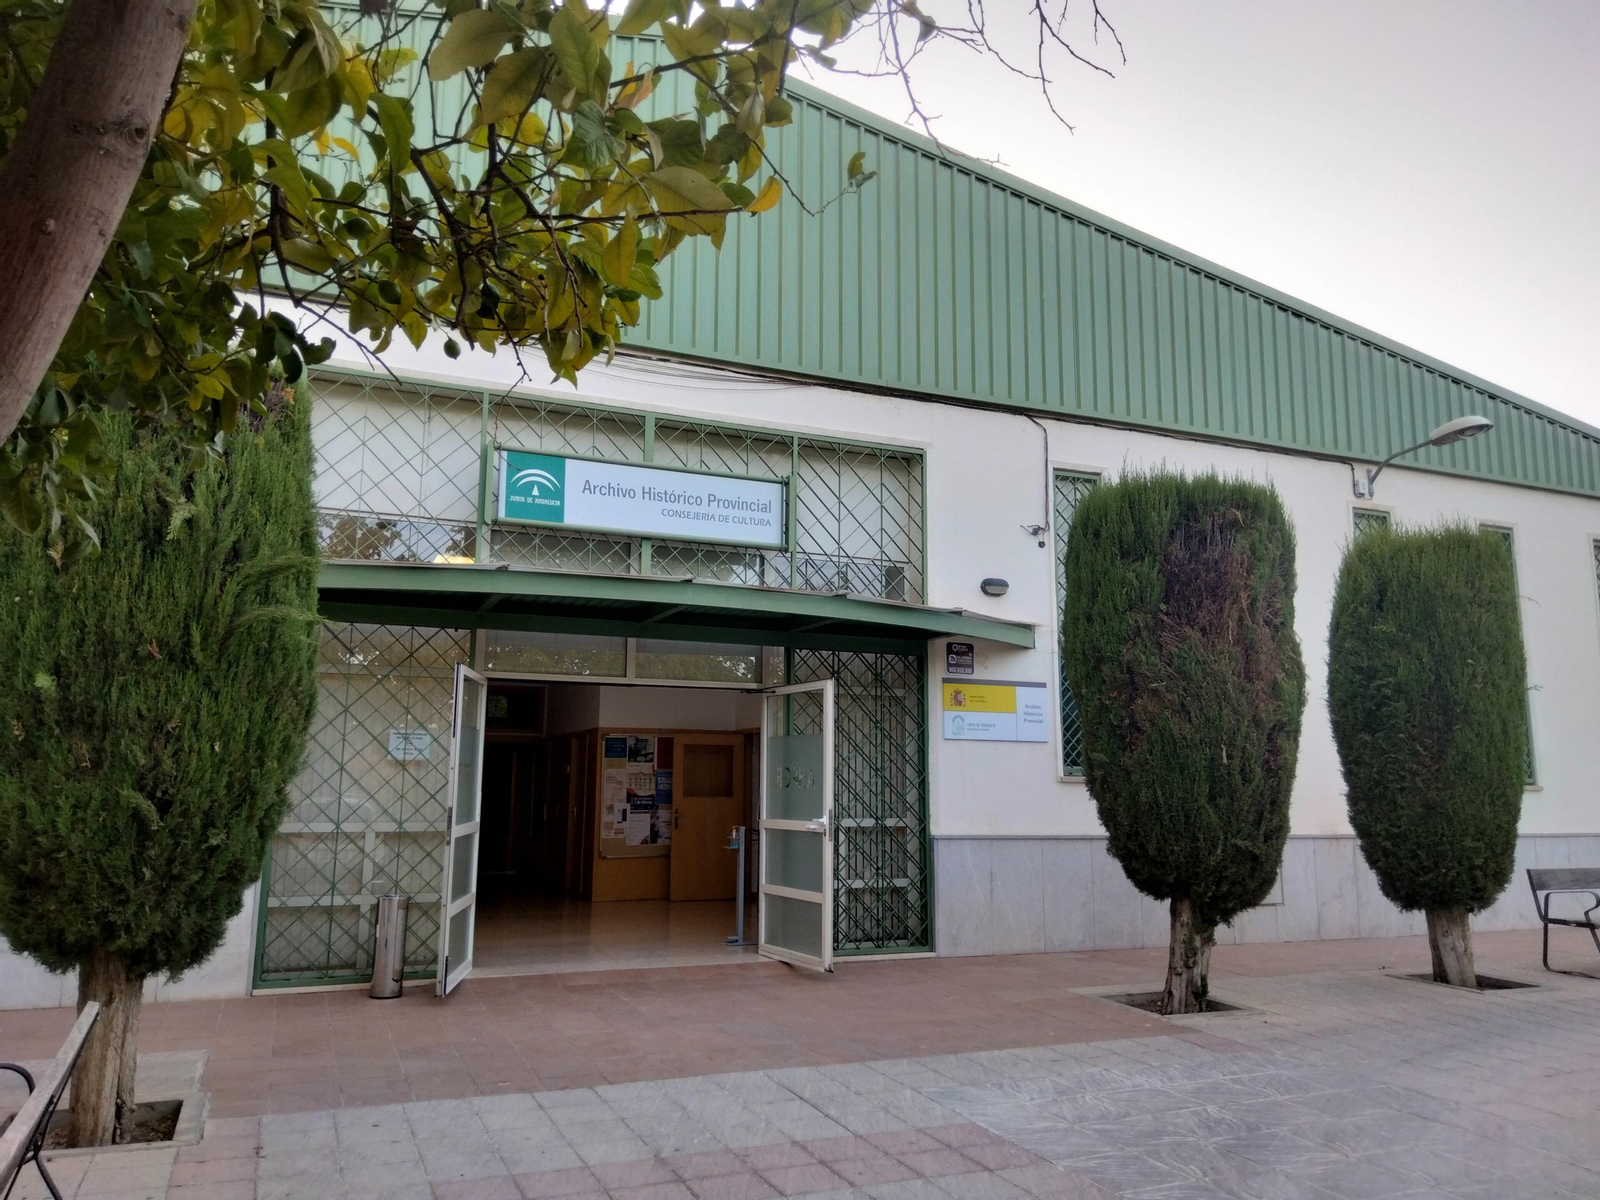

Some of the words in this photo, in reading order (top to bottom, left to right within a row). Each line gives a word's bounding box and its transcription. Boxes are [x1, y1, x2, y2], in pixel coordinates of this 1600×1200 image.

[509, 495, 525, 503] JUNTA
[582, 479, 636, 499] Archivo
[641, 485, 703, 506] Histórico
[707, 493, 772, 514] Provincial
[718, 514, 730, 523] DE
[732, 515, 772, 527] CULTURA
